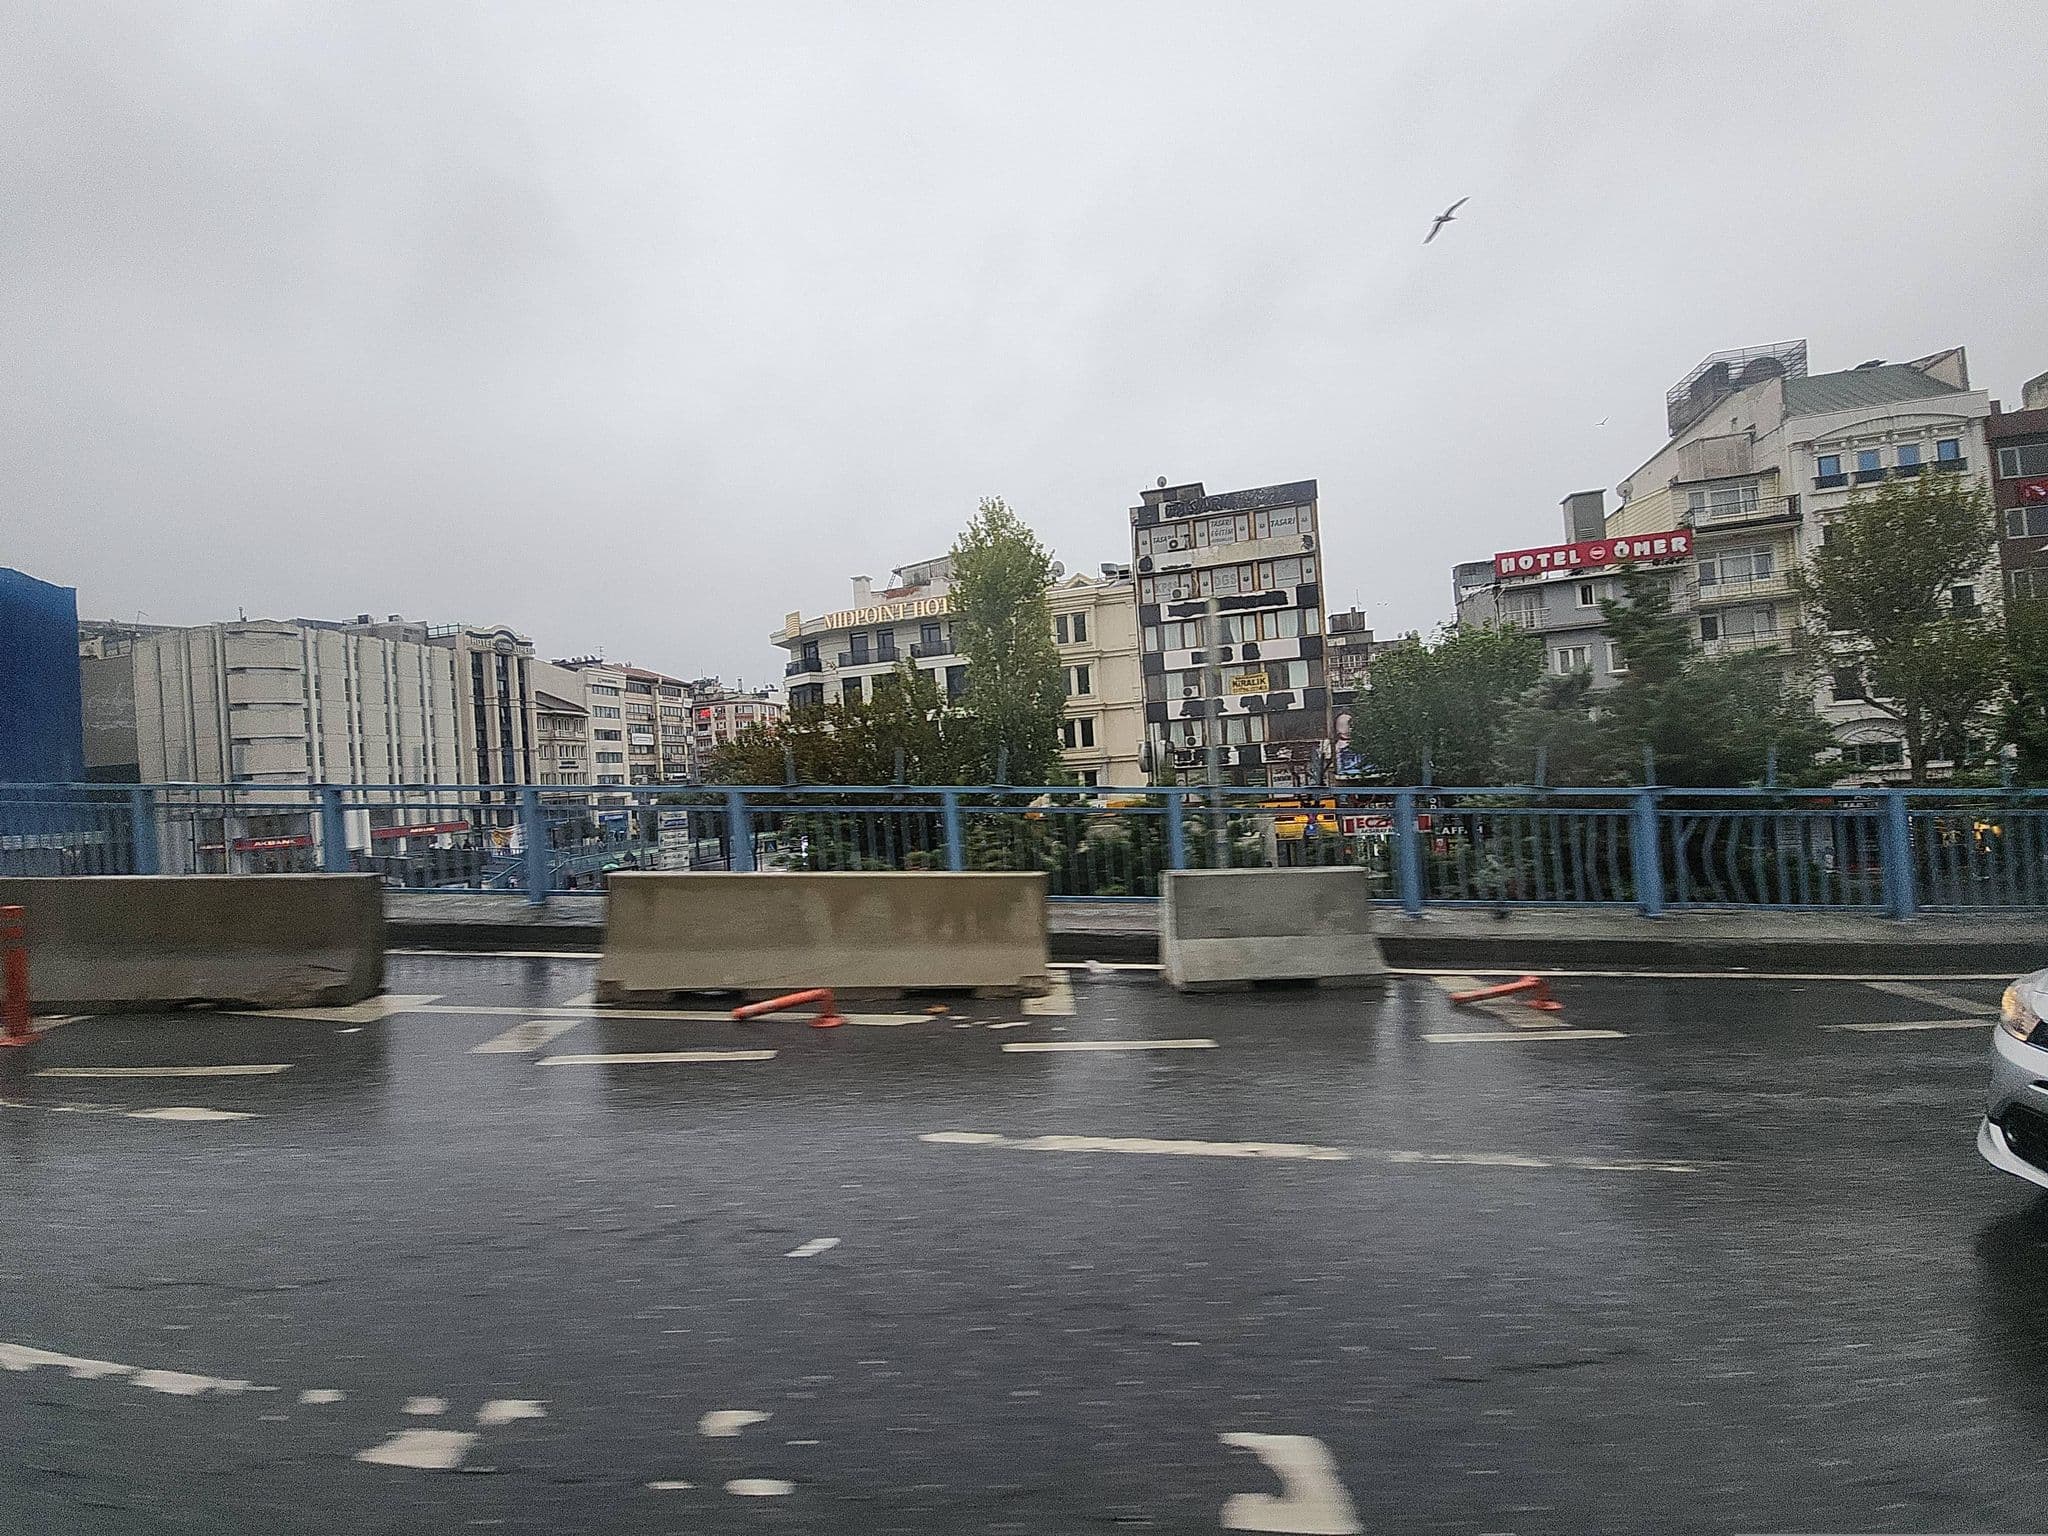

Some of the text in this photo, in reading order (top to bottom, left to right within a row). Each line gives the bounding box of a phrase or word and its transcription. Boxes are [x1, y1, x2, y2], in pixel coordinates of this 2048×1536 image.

[1209, 518, 1233, 527] TASARI
[1270, 516, 1296, 528] TASARI
[1501, 536, 1688, 574] HOTEL ÖMER
[823, 601, 908, 630] MIDPOINT
[254, 839, 297, 847] AKBANK
